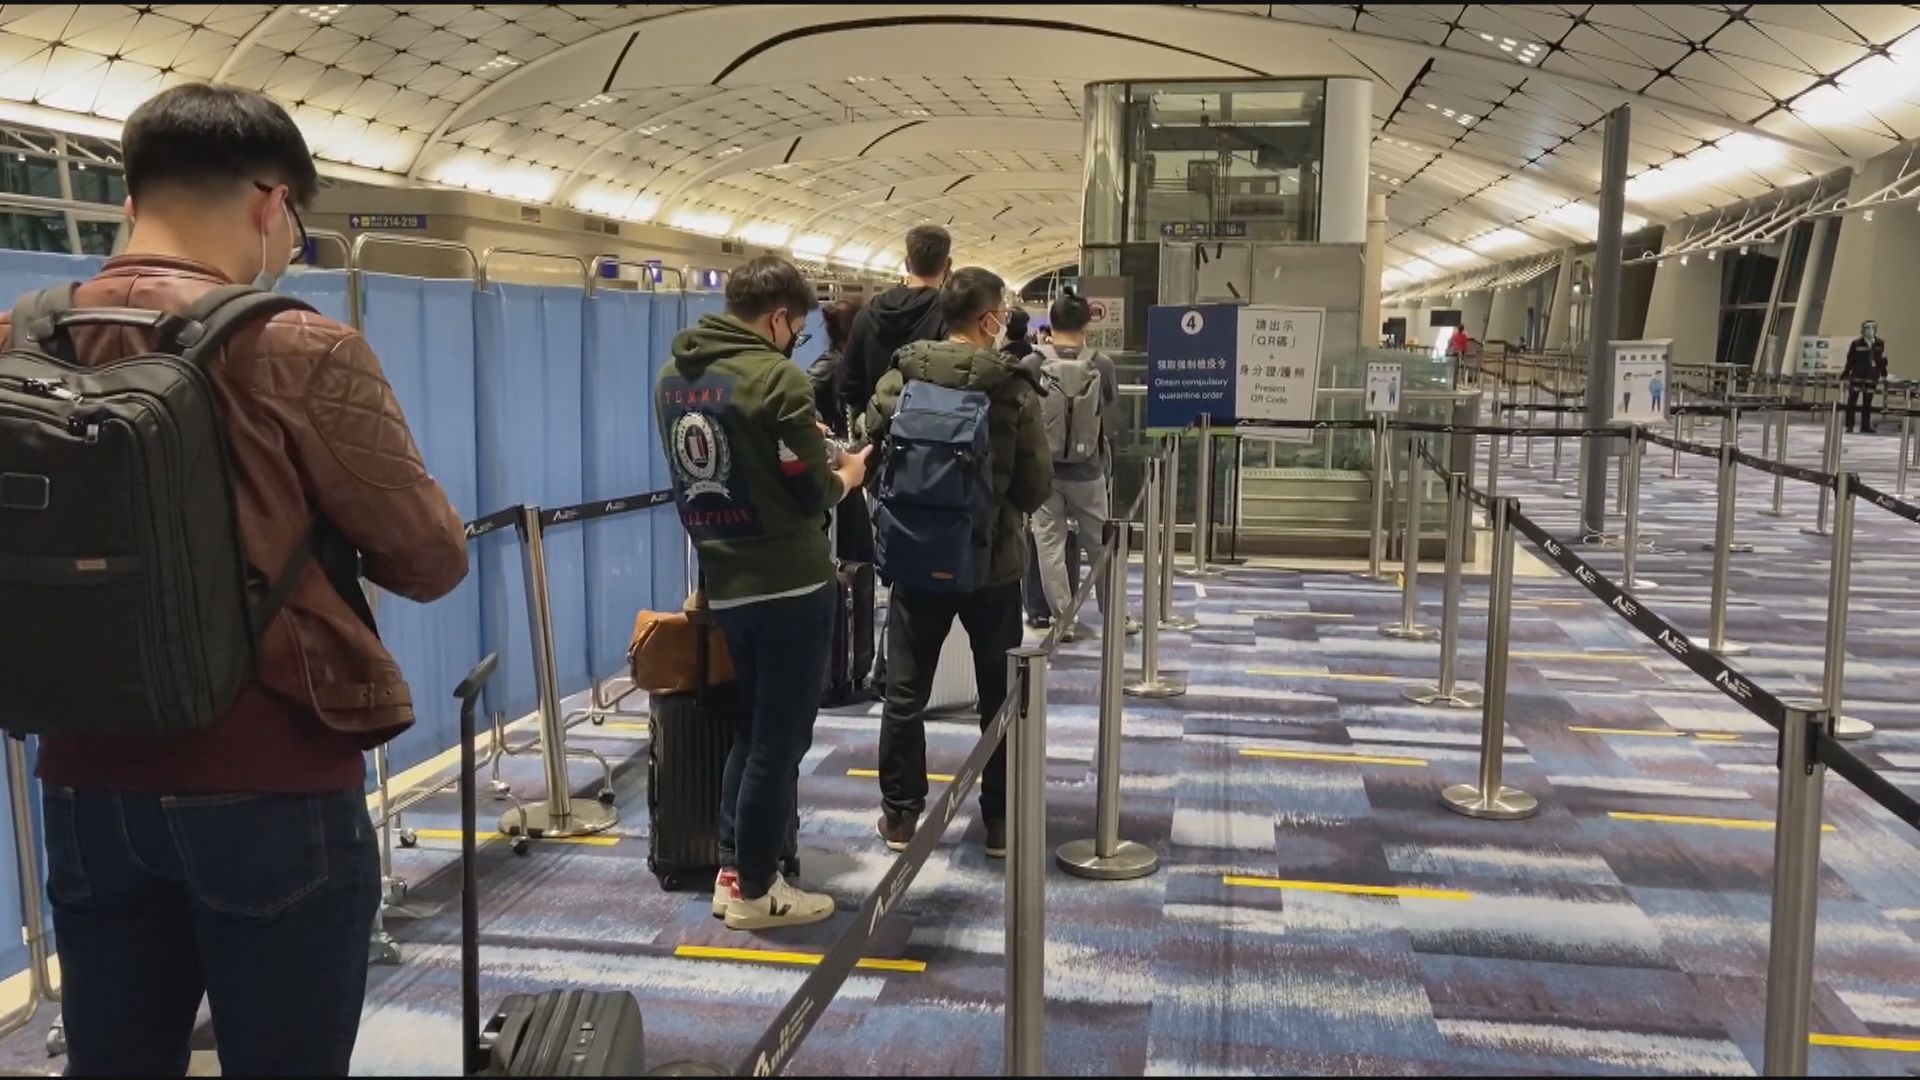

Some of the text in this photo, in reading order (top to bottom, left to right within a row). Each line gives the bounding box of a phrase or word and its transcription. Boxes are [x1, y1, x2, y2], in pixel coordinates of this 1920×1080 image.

[1186, 315, 1197, 330] 4
[1256, 318, 1293, 331] 請出示
[1155, 377, 1228, 388] Obtain compulsory
[1255, 383, 1286, 393] Present
[665, 386, 724, 405] TOMMY
[1159, 390, 1224, 401] quarantine order
[1251, 394, 1288, 405] QR Code
